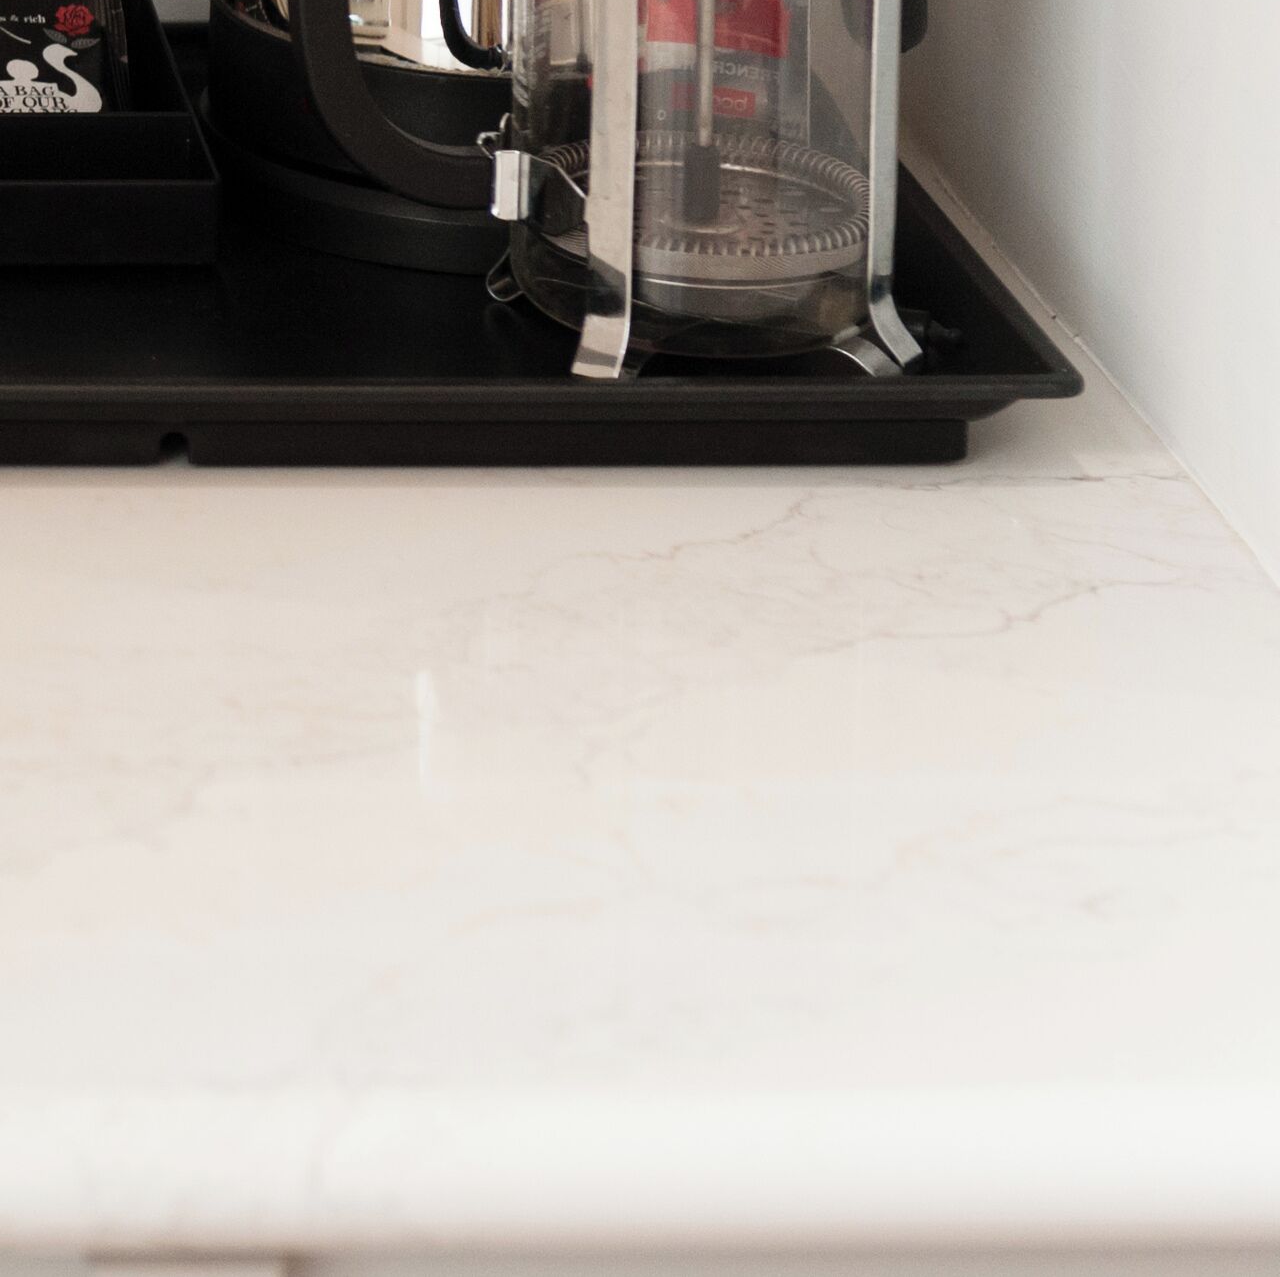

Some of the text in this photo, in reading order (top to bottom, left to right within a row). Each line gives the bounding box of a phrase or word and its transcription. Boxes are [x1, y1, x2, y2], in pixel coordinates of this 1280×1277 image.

[23, 14, 46, 24] rich
[14, 85, 55, 96] BAG
[22, 97, 69, 109] OUR
